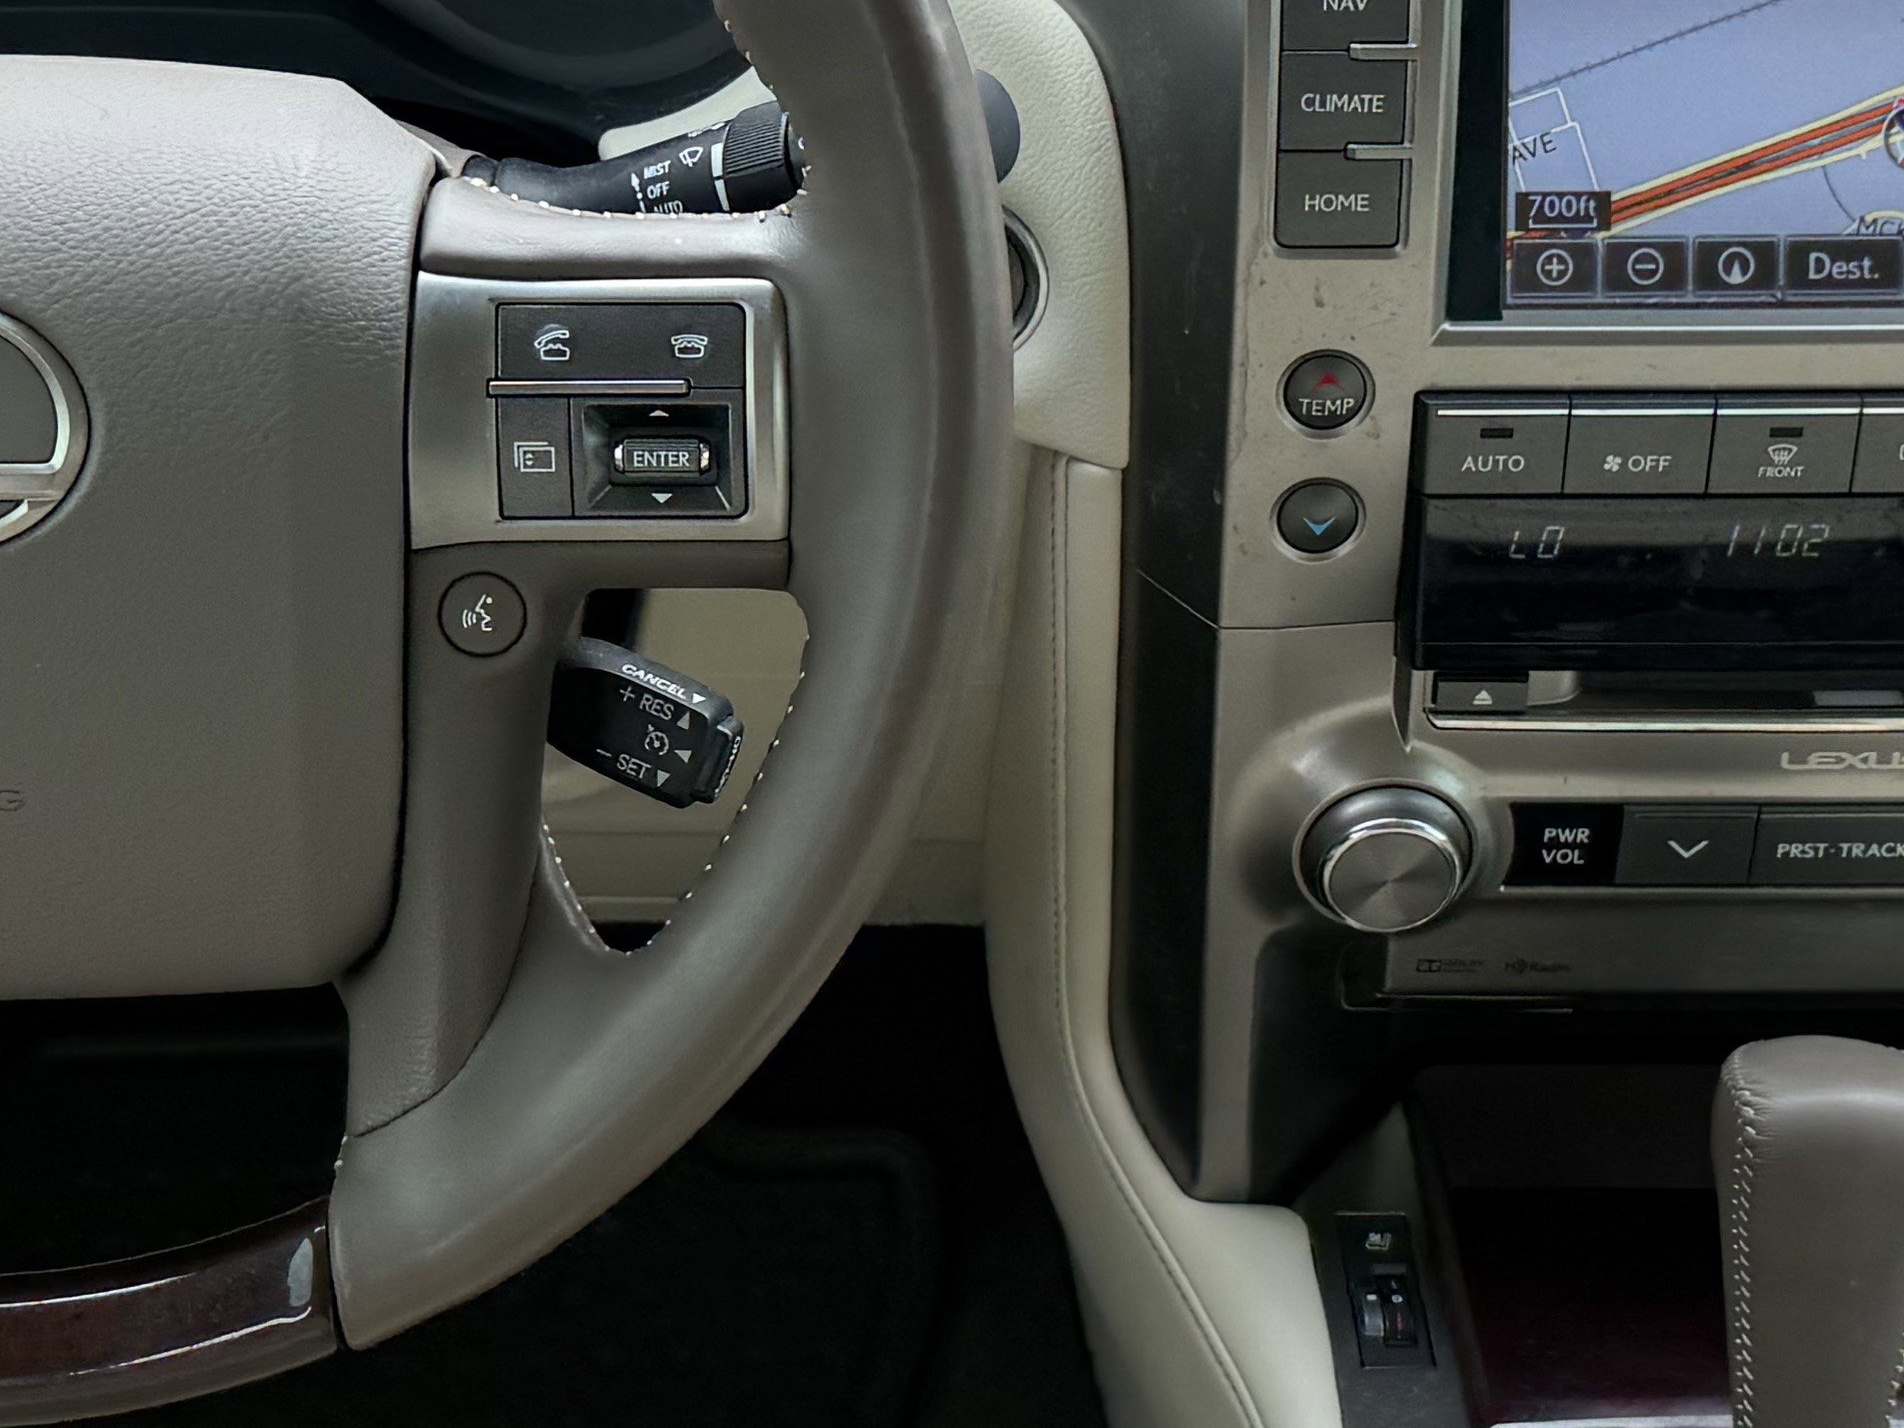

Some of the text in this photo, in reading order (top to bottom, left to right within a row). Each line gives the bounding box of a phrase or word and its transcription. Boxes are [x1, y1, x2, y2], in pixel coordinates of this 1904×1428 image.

[1300, 93, 1385, 114] CLIMATE
[1510, 131, 1557, 165] AVE
[643, 160, 672, 179] MIST
[646, 181, 671, 199] OFF
[1303, 193, 1370, 212] HOME
[1528, 195, 1596, 218] 700ft
[1807, 251, 1879, 281] Dest.
[1298, 397, 1356, 418] TEMP
[632, 450, 691, 468] ENTER
[1460, 454, 1525, 473] AUTO
[1627, 454, 1672, 473] OFF
[1757, 464, 1804, 478] FRONT
[621, 663, 688, 701] CANCEL
[638, 692, 675, 721] RES
[616, 753, 652, 780] SET
[1543, 827, 1590, 844] PWR
[1541, 848, 1585, 866] VOL
